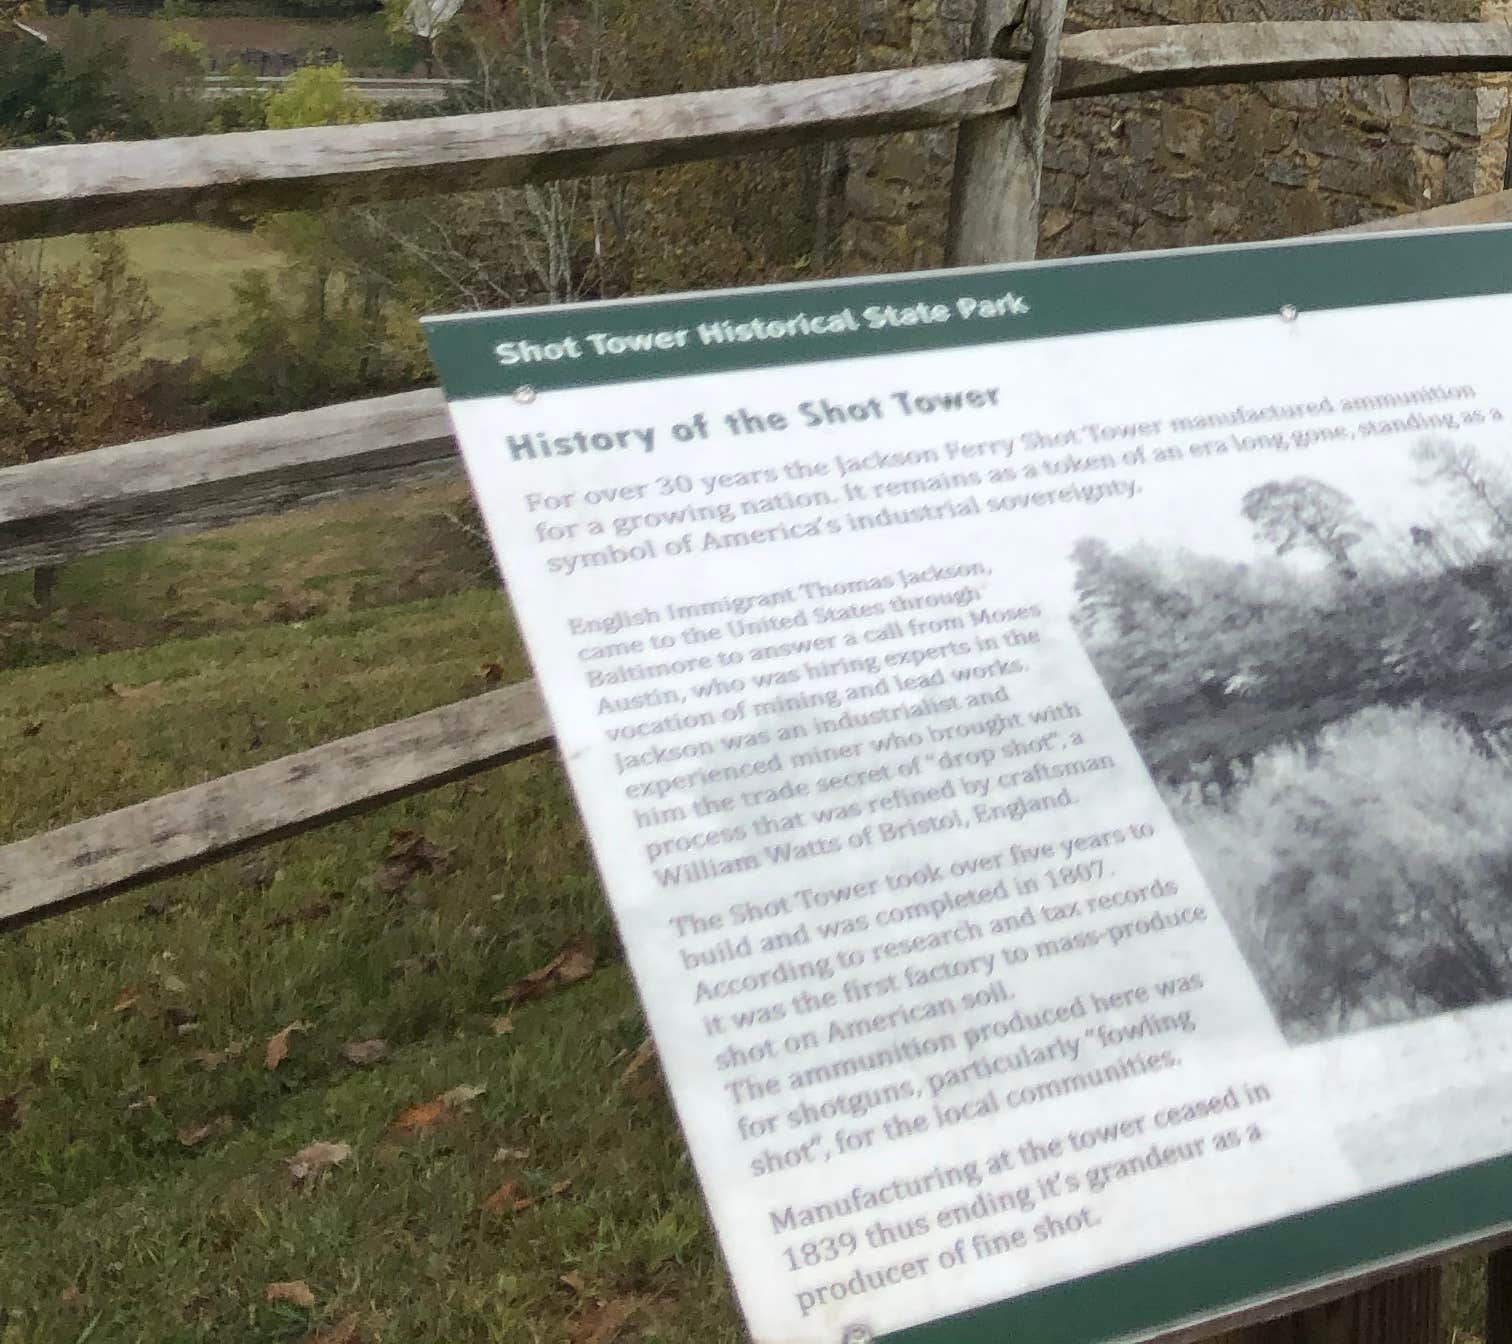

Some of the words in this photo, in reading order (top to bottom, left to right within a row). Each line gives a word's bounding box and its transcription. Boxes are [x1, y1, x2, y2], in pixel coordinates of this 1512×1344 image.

[495, 336, 583, 365] Shot
[587, 329, 691, 356] Tower
[696, 307, 860, 345] Historical
[862, 302, 952, 328] State
[953, 291, 1030, 319] Park
[505, 426, 660, 461] History
[671, 413, 713, 442] of
[724, 407, 789, 436] the
[797, 396, 886, 427] Shot
[891, 386, 1006, 416] Tower
[524, 490, 576, 512] For
[583, 483, 646, 505] over
[655, 473, 694, 496] 30
[700, 468, 779, 495] years
[782, 459, 831, 480] the
[833, 449, 940, 478] Jackson
[943, 439, 1019, 461] Ferry
[1019, 429, 1082, 452] Shot
[1082, 422, 1164, 444] Tower
[1169, 397, 1336, 434] manufactured
[1339, 384, 1477, 413] ammunition
[534, 521, 579, 542] for
[587, 519, 605, 535] a
[611, 503, 737, 537] growing
[739, 491, 839, 516] nation.
[842, 483, 867, 502] It
[871, 472, 983, 499] remains
[987, 468, 1017, 484] as
[1021, 465, 1039, 480] a
[1041, 454, 1117, 477] token
[1121, 447, 1149, 467] of
[1152, 447, 1184, 463] an
[1188, 441, 1229, 459] era
[1230, 434, 1291, 453] long
[1289, 426, 1356, 450] gone,
[1357, 412, 1461, 437] standing
[1460, 409, 1486, 424] as
[1489, 407, 1503, 421] a
[546, 538, 658, 574] symbol
[664, 533, 696, 556] of
[845, 496, 981, 532] industrial
[986, 480, 1143, 514] sovereignty.
[567, 604, 661, 634] English
[665, 587, 797, 620] Immigrant
[798, 576, 896, 601] Thomas
[578, 638, 645, 660] came
[649, 632, 676, 650] to
[680, 624, 723, 645] the
[725, 609, 809, 638] United
[811, 602, 886, 625] States
[888, 584, 982, 614] through
[584, 655, 713, 687] Baltimore
[716, 650, 744, 667] to
[748, 636, 835, 662] answer
[843, 632, 859, 647] a
[863, 621, 905, 644] call
[907, 616, 965, 637] from
[968, 605, 1041, 628] Moses
[690, 674, 746, 698] who
[751, 667, 801, 688] was
[802, 655, 882, 680] hiring
[883, 639, 972, 667] experts
[973, 634, 1001, 652] in
[1001, 627, 1041, 647] the
[668, 907, 724, 938] The
[728, 892, 793, 925] Shot
[793, 878, 880, 911] Tower
[885, 859, 945, 892] took
[950, 851, 1007, 879] over
[1006, 841, 1056, 866] five
[1059, 827, 1126, 861] years
[1128, 820, 1155, 841] to
[678, 930, 754, 969] build
[760, 918, 812, 952] and
[816, 912, 870, 940] was
[875, 877, 1011, 927] completed
[1012, 875, 1040, 898] in
[724, 1071, 782, 1106] The
[787, 1031, 957, 1090] ammunition
[962, 993, 1089, 1053] produced
[1089, 984, 1150, 1015] here
[1154, 971, 1204, 1000] was
[734, 1112, 777, 1140] for
[925, 1035, 1087, 1100] particularly
[832, 1126, 878, 1155] for
[881, 1110, 930, 1142] the
[932, 1087, 1003, 1129] local
[768, 1159, 984, 1234] Manufacturing
[985, 1146, 1015, 1176] at
[1017, 1134, 1064, 1167] the
[1067, 1115, 1148, 1154] tower
[1153, 1083, 1242, 1131] ceased
[1240, 1081, 1271, 1107] in
[780, 1224, 860, 1272] 1839
[864, 1212, 931, 1249] thus
[936, 1184, 1037, 1230] ending
[1084, 1137, 1208, 1195] grandeur
[1212, 1127, 1242, 1153] as
[1246, 1122, 1262, 1144] a
[795, 1252, 932, 1317] producer
[938, 1235, 970, 1270] of
[968, 1226, 1028, 1260] fine
